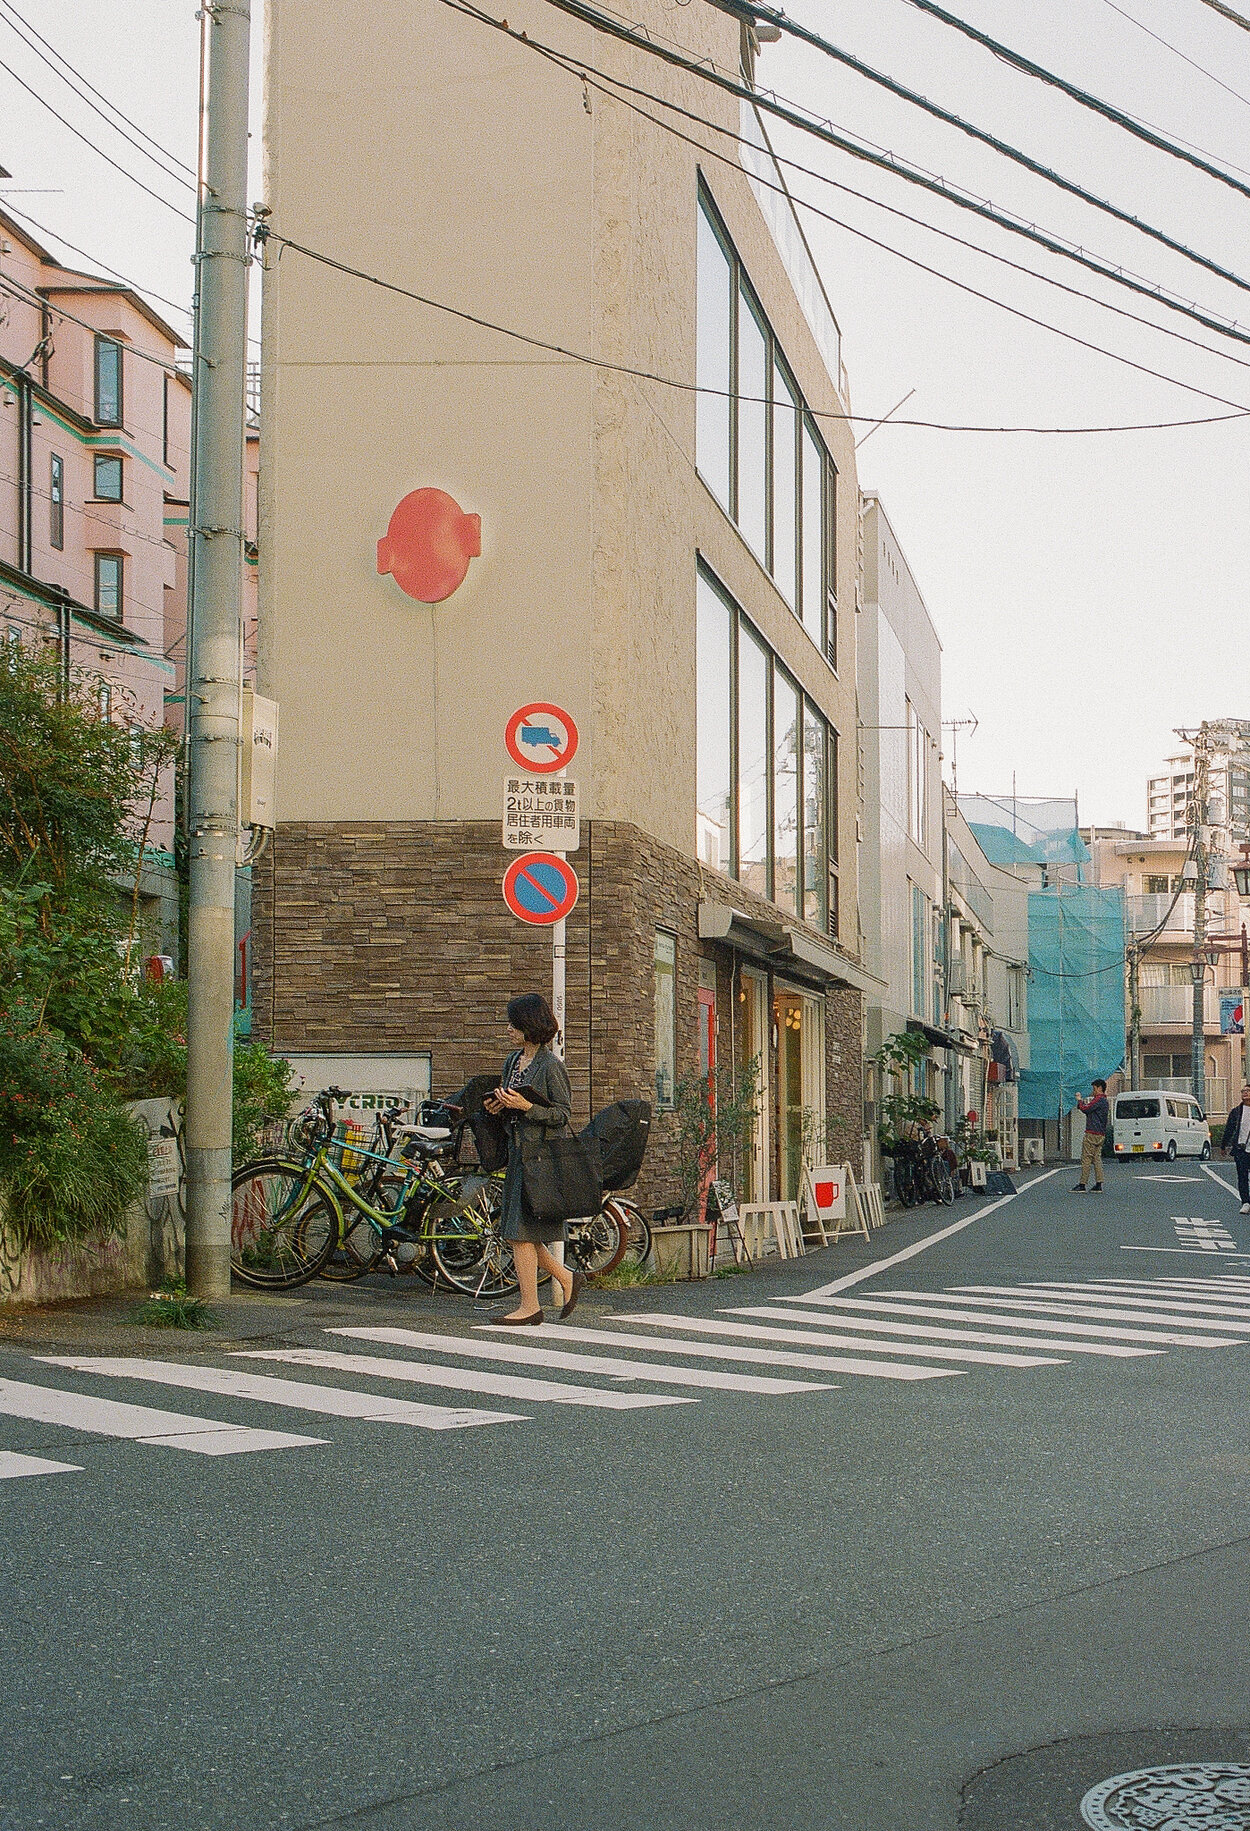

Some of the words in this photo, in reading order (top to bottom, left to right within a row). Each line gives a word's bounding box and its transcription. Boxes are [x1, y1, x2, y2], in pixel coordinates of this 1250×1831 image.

[507, 779, 576, 796] 最大積載量
[507, 796, 576, 813] 2t以上の貨物
[507, 813, 576, 830] 居住者用車両
[507, 830, 544, 846] を除く
